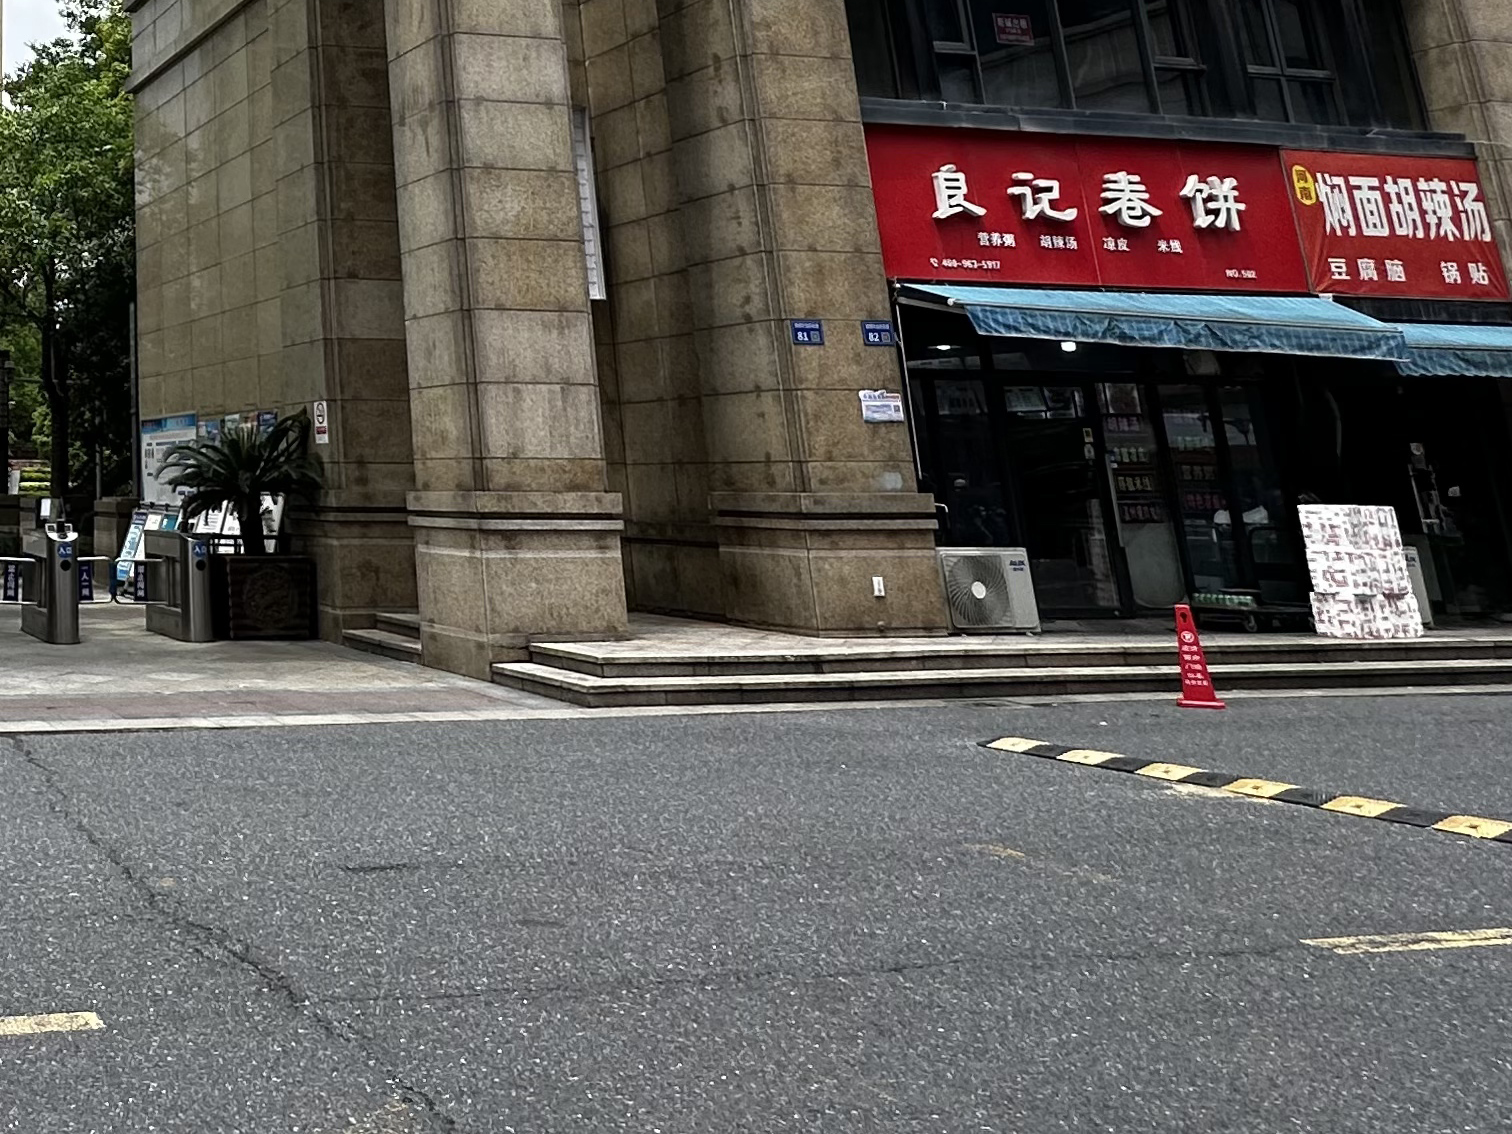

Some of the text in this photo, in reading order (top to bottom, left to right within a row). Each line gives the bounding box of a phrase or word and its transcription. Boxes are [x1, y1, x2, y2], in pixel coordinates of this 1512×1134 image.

[931, 164, 1246, 231] 良记卷饼
[1315, 172, 1492, 242] 焖面胡辣汤
[1327, 257, 1489, 285] 豆腐脑 锅贴
[797, 331, 809, 341] 81
[868, 332, 880, 342] 82
